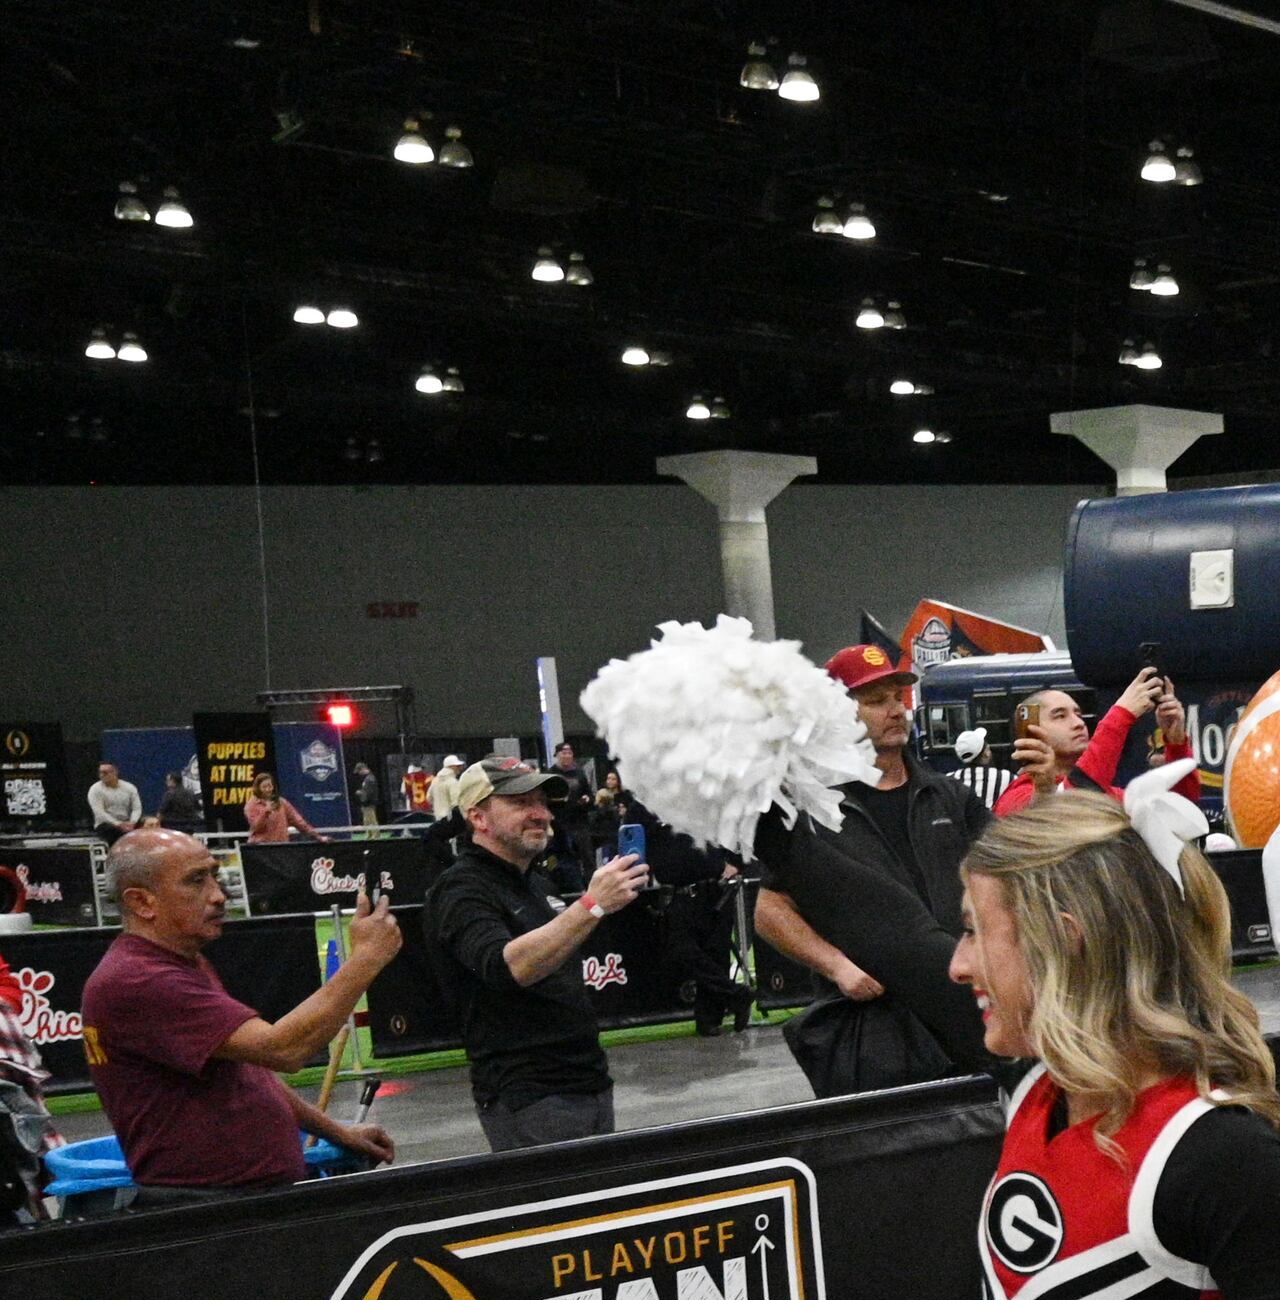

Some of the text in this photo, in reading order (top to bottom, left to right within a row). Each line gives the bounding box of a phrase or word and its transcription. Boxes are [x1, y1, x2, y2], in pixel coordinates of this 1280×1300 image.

[207, 742, 266, 760] PUPPIES
[210, 764, 254, 782] AT THE
[984, 1172, 1063, 1272] G
[551, 1220, 735, 1288] PLAYOFF
